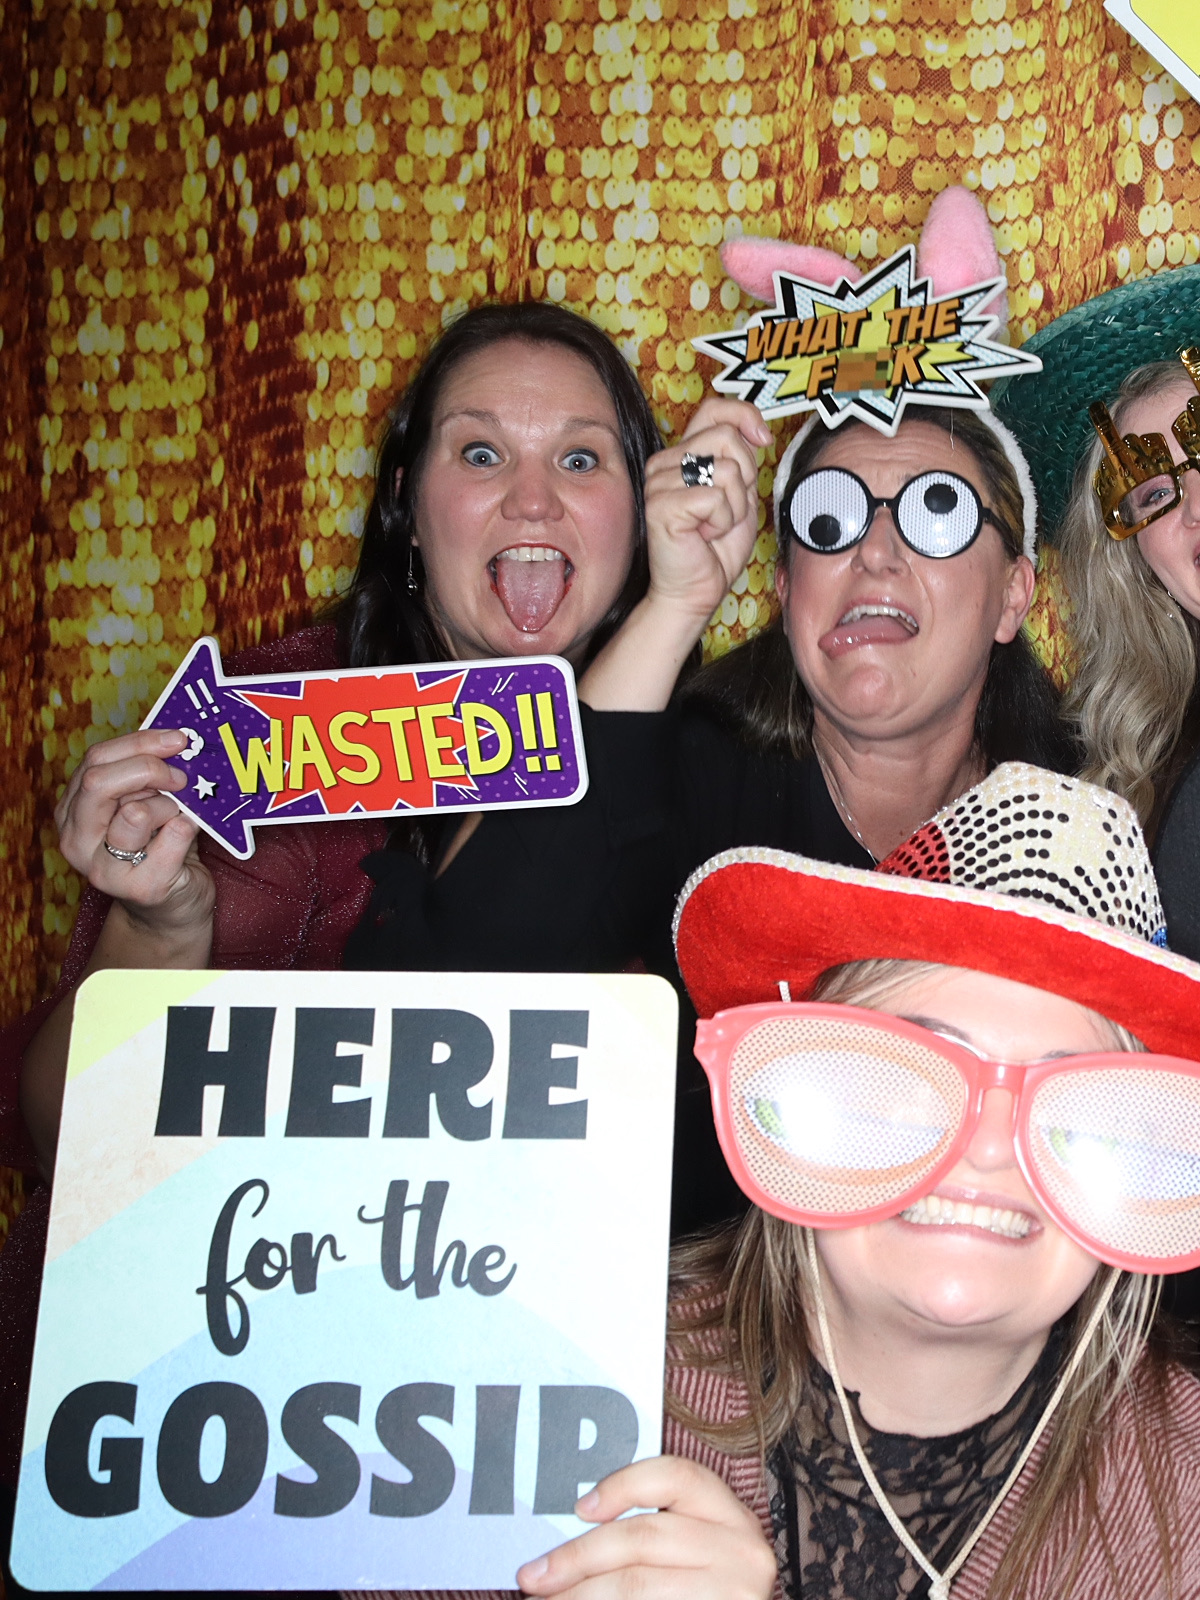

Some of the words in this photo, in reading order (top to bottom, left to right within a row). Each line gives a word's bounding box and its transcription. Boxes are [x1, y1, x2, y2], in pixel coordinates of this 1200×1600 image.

[745, 308, 869, 363] WHAT
[884, 297, 965, 346] THE
[806, 344, 928, 400] FK
[218, 691, 563, 794] WASTED!!
[154, 1005, 590, 1142] HERE
[195, 1178, 347, 1357] for
[357, 1179, 518, 1299] the
[44, 1380, 640, 1519] GOSSIP
